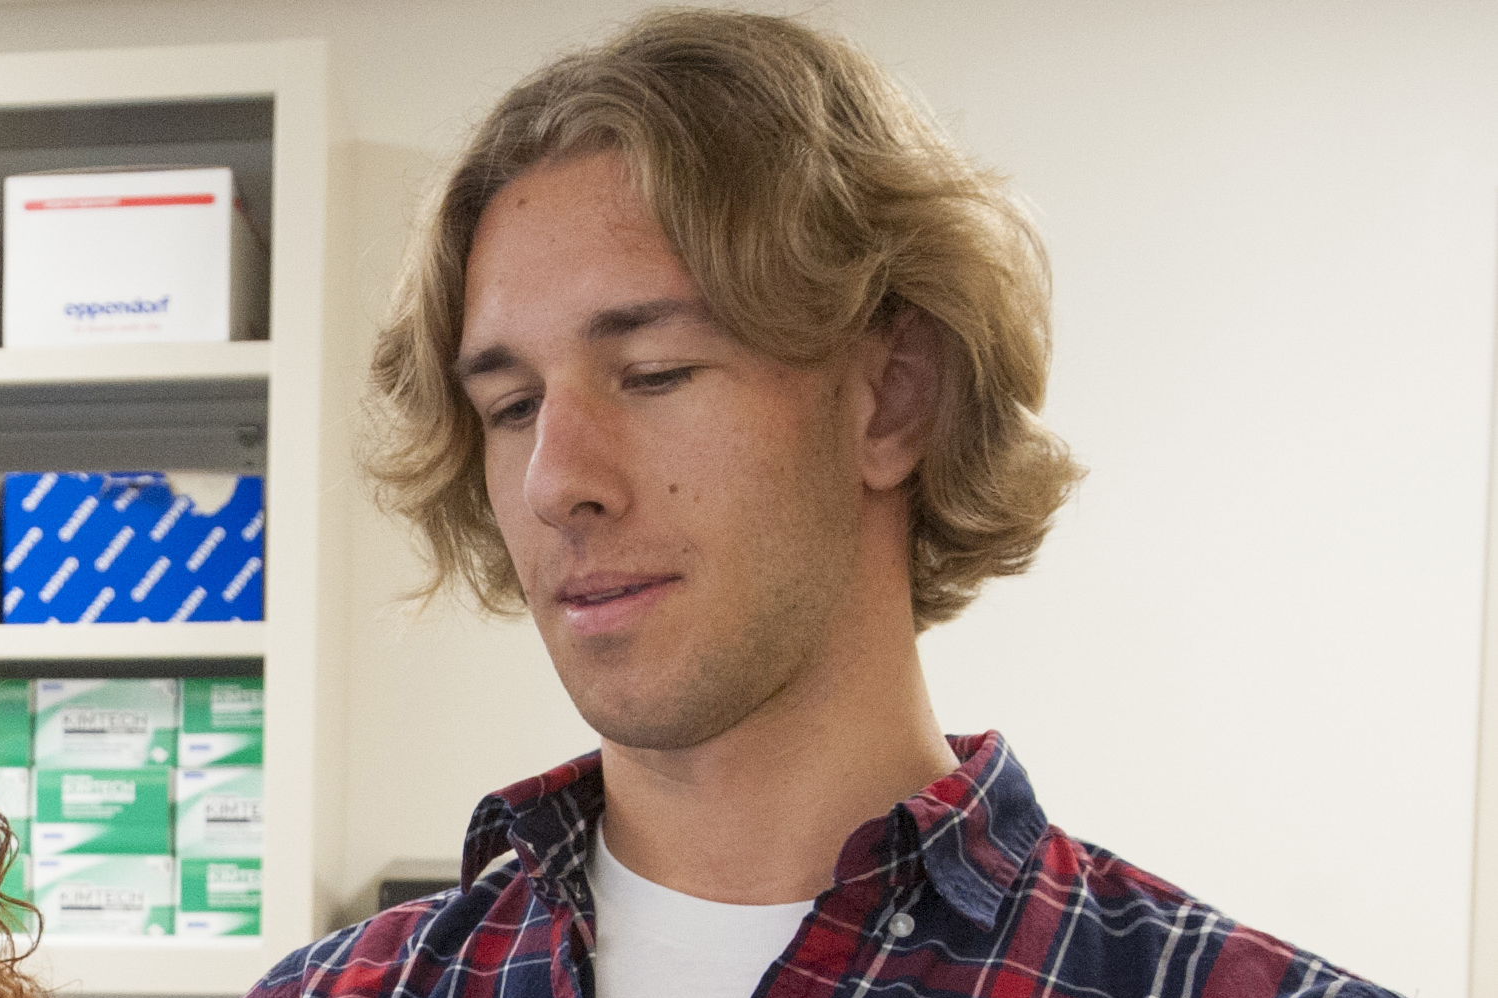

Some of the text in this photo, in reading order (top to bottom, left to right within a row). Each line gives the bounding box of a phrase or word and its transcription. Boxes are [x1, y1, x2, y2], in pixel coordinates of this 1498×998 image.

[63, 296, 170, 319] eppendorf
[62, 712, 147, 729] KIMTECH
[60, 888, 144, 905] KIMTECH
